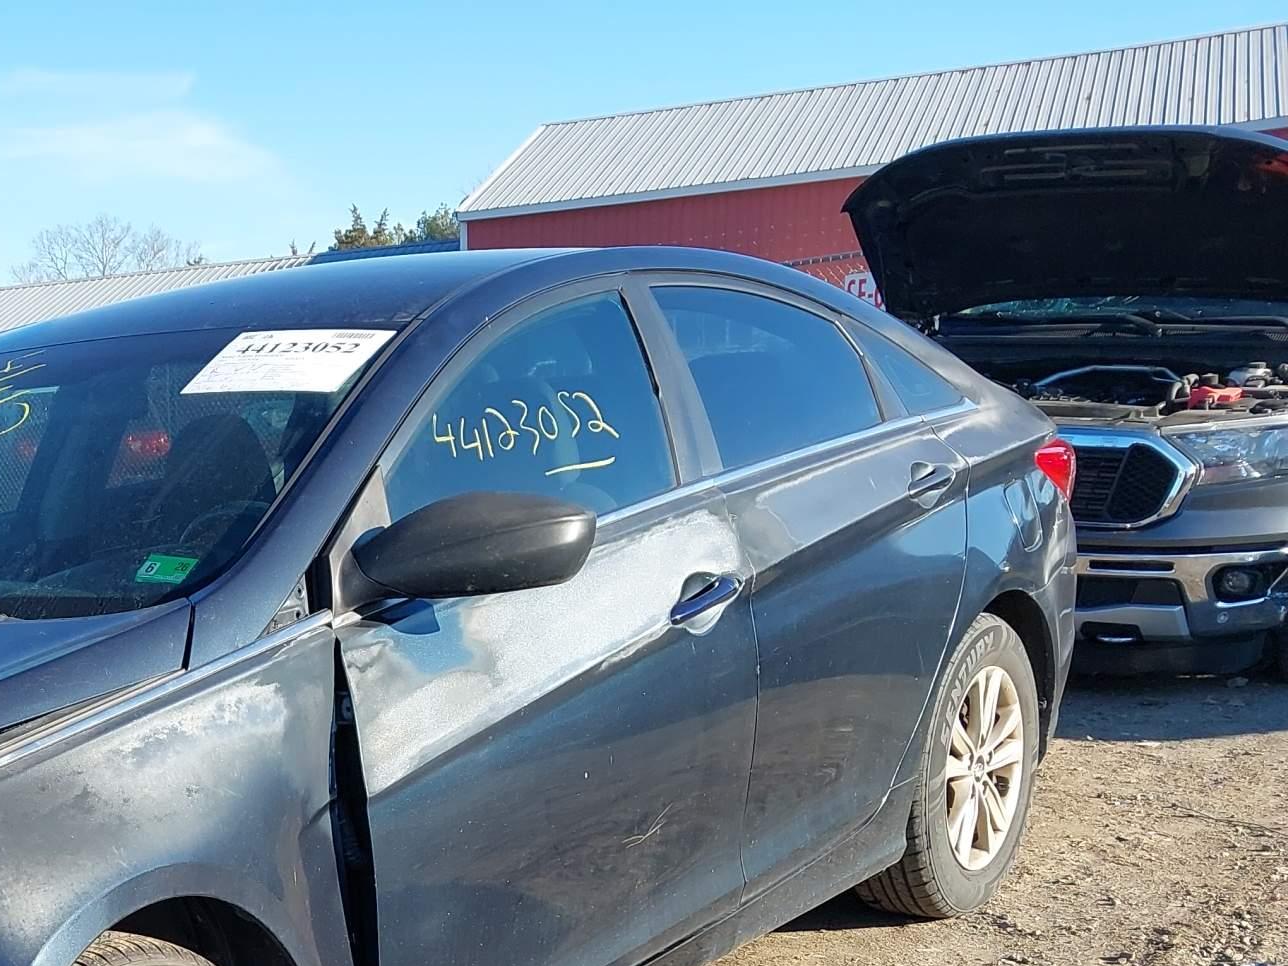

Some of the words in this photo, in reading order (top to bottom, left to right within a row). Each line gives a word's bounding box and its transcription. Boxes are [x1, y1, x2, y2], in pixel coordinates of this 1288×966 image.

[236, 342, 361, 354] 44123052
[432, 391, 619, 461] 44123052
[145, 563, 157, 573] 6
[940, 630, 995, 746] SENTURY
